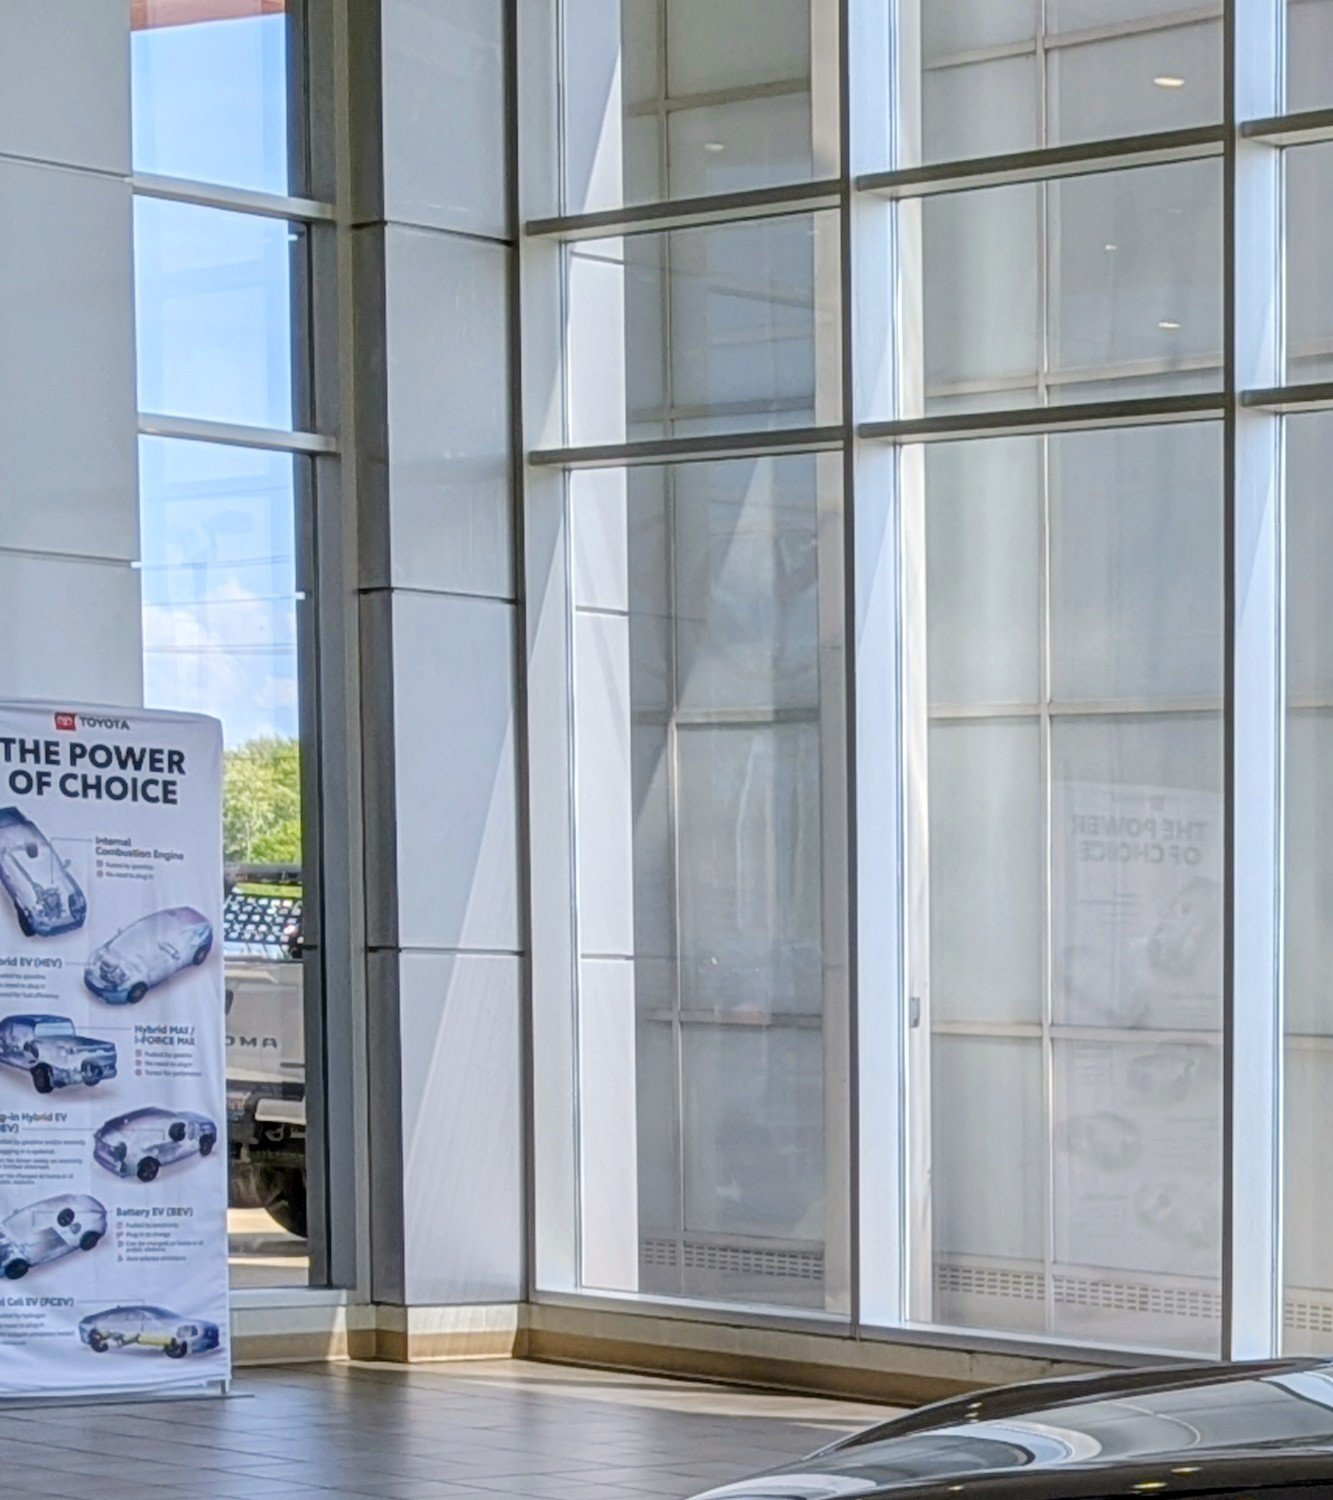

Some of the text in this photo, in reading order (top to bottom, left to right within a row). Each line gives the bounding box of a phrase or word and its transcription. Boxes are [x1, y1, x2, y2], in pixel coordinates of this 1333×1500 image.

[80, 716, 131, 731] TOYOTA
[0, 737, 186, 776] THE POWER
[8, 770, 178, 805] OF CHOICE
[95, 846, 152, 859] Combustion
[116, 1207, 150, 1218] Battery
[152, 1207, 165, 1217] EV
